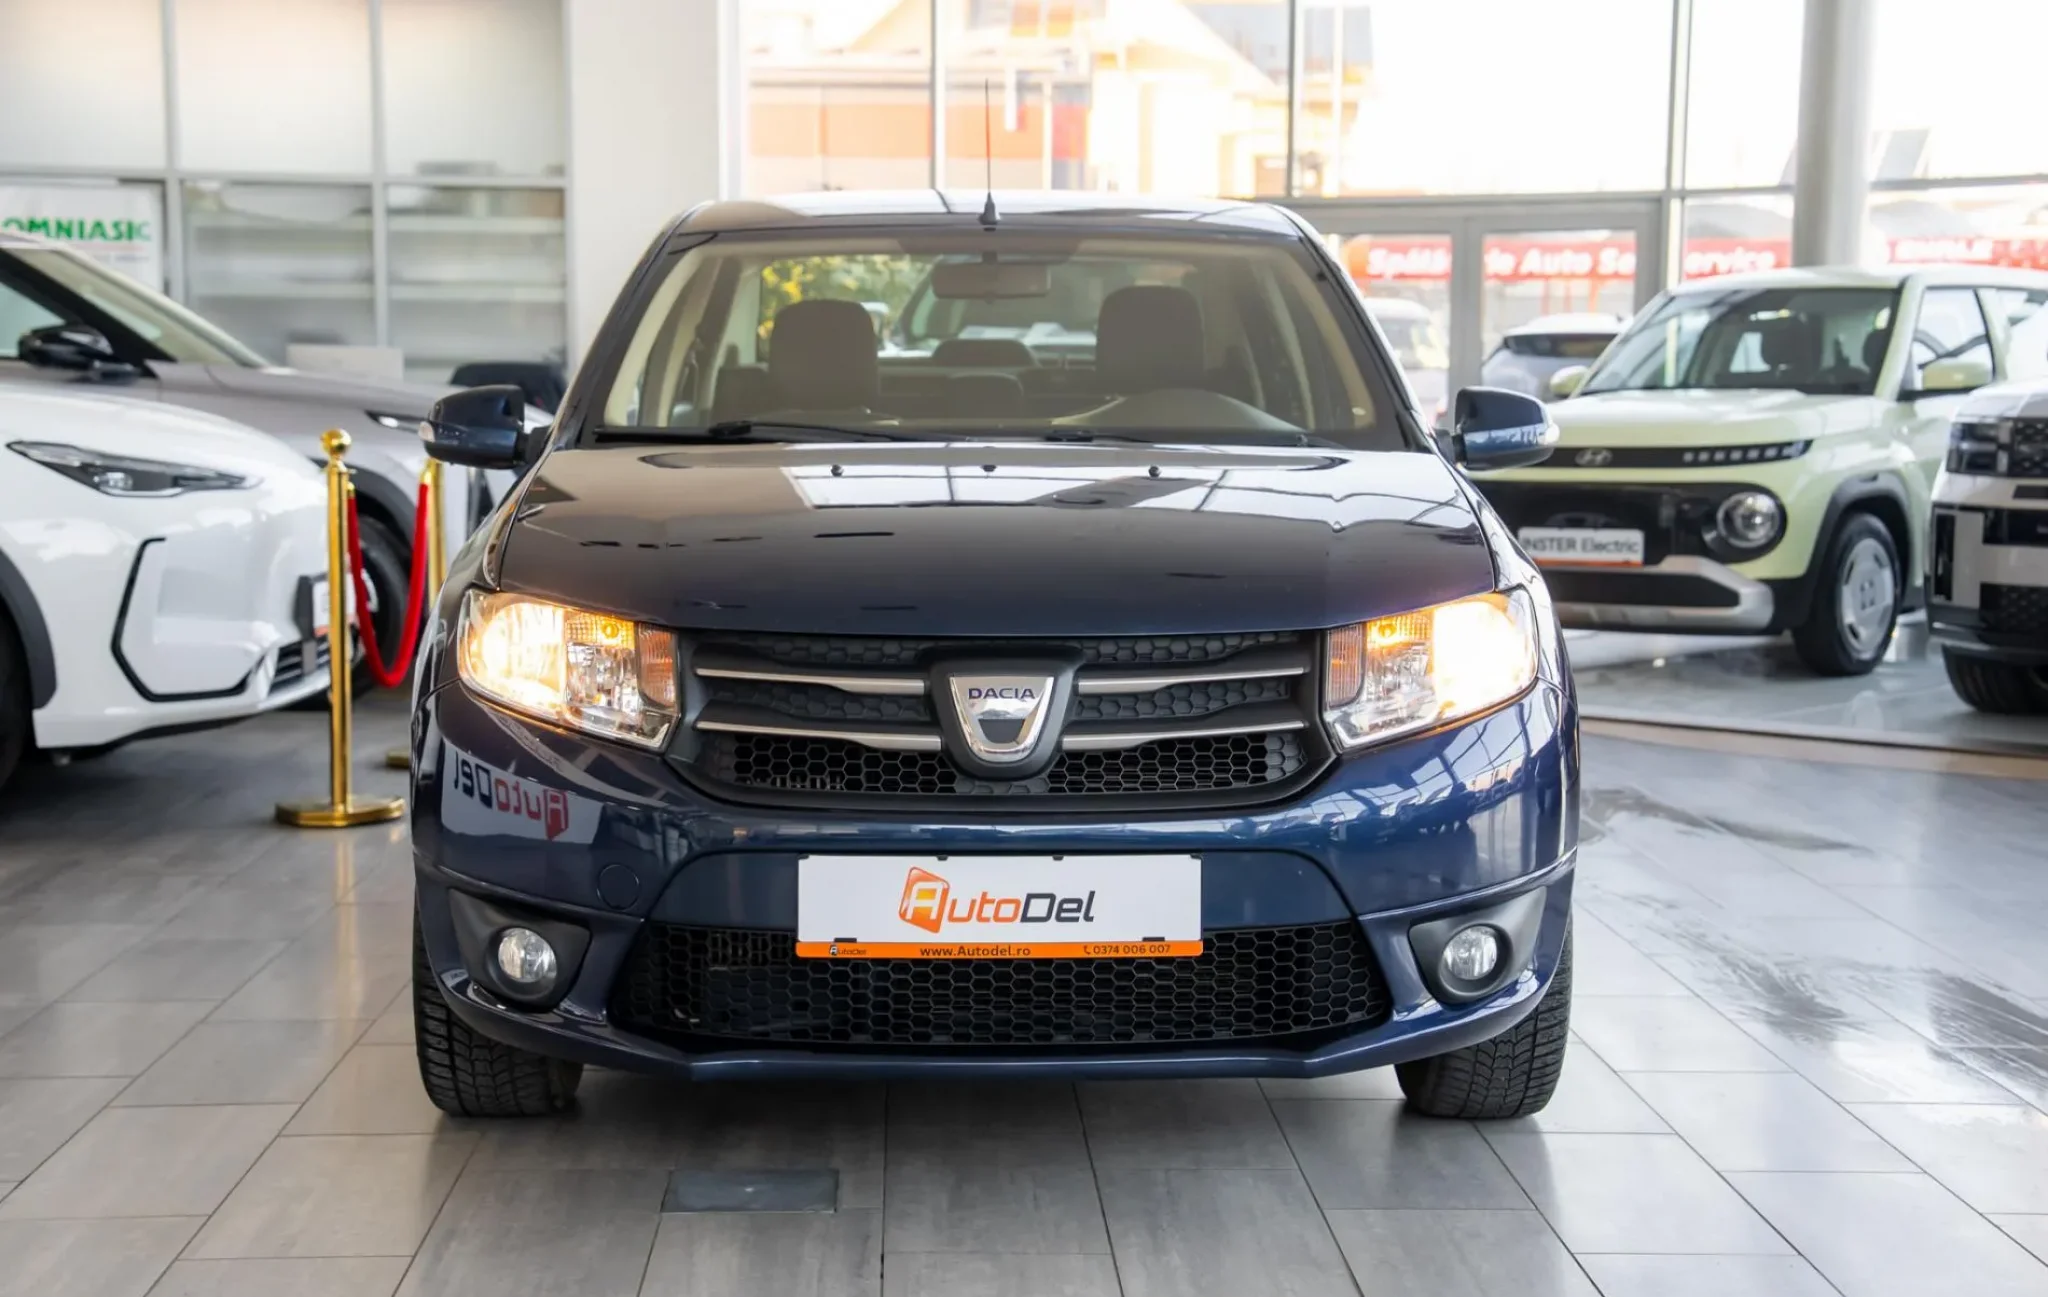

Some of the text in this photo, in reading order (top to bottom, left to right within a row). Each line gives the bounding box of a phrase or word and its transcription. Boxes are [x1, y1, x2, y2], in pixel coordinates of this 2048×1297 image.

[1581, 537, 1639, 554] Electric
[968, 688, 1035, 699] DACIA
[898, 866, 1096, 934] AutoDel
[920, 945, 1031, 957] www.Autodel.ro
[1093, 946, 1119, 955] 0374
